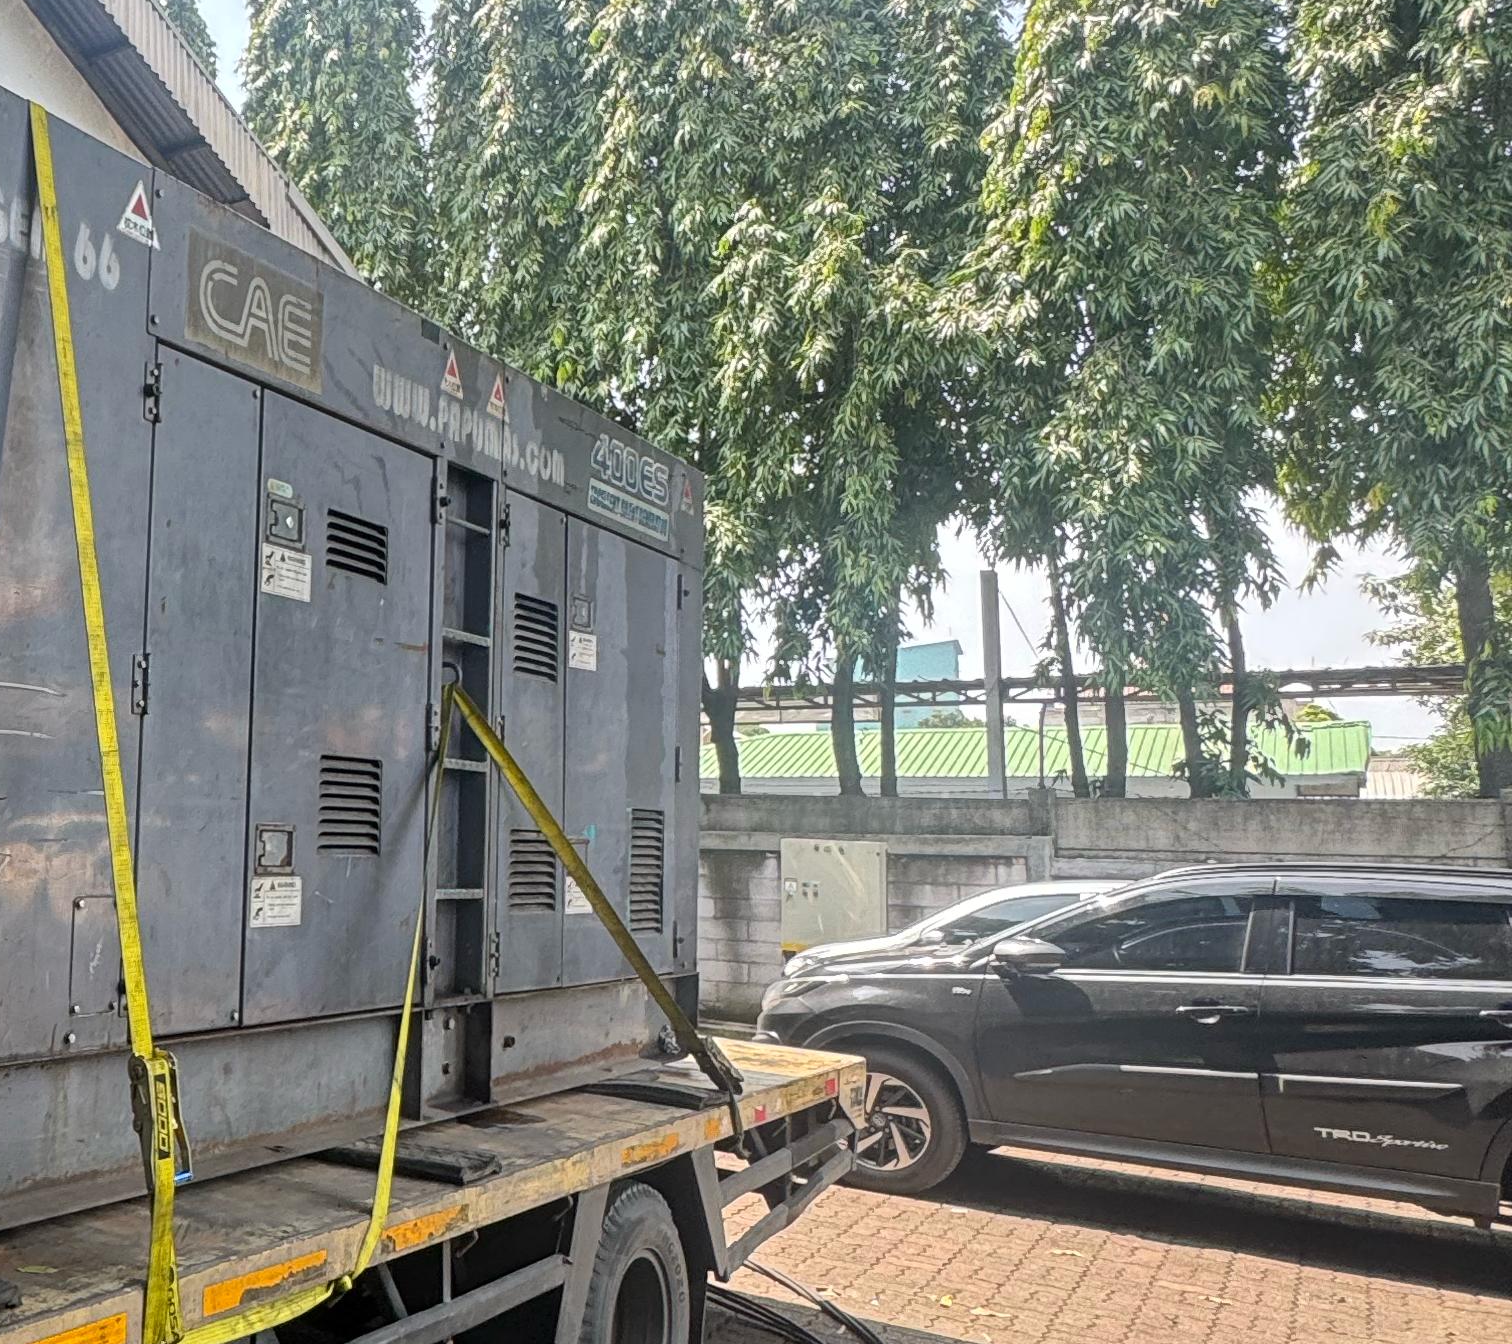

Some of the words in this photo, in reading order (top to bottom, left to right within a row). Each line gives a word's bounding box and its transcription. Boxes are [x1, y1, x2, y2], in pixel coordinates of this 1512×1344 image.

[73, 221, 121, 290] 66
[199, 259, 313, 375] CAE
[591, 433, 670, 506] 400ES
[1313, 1126, 1371, 1143] TRD
